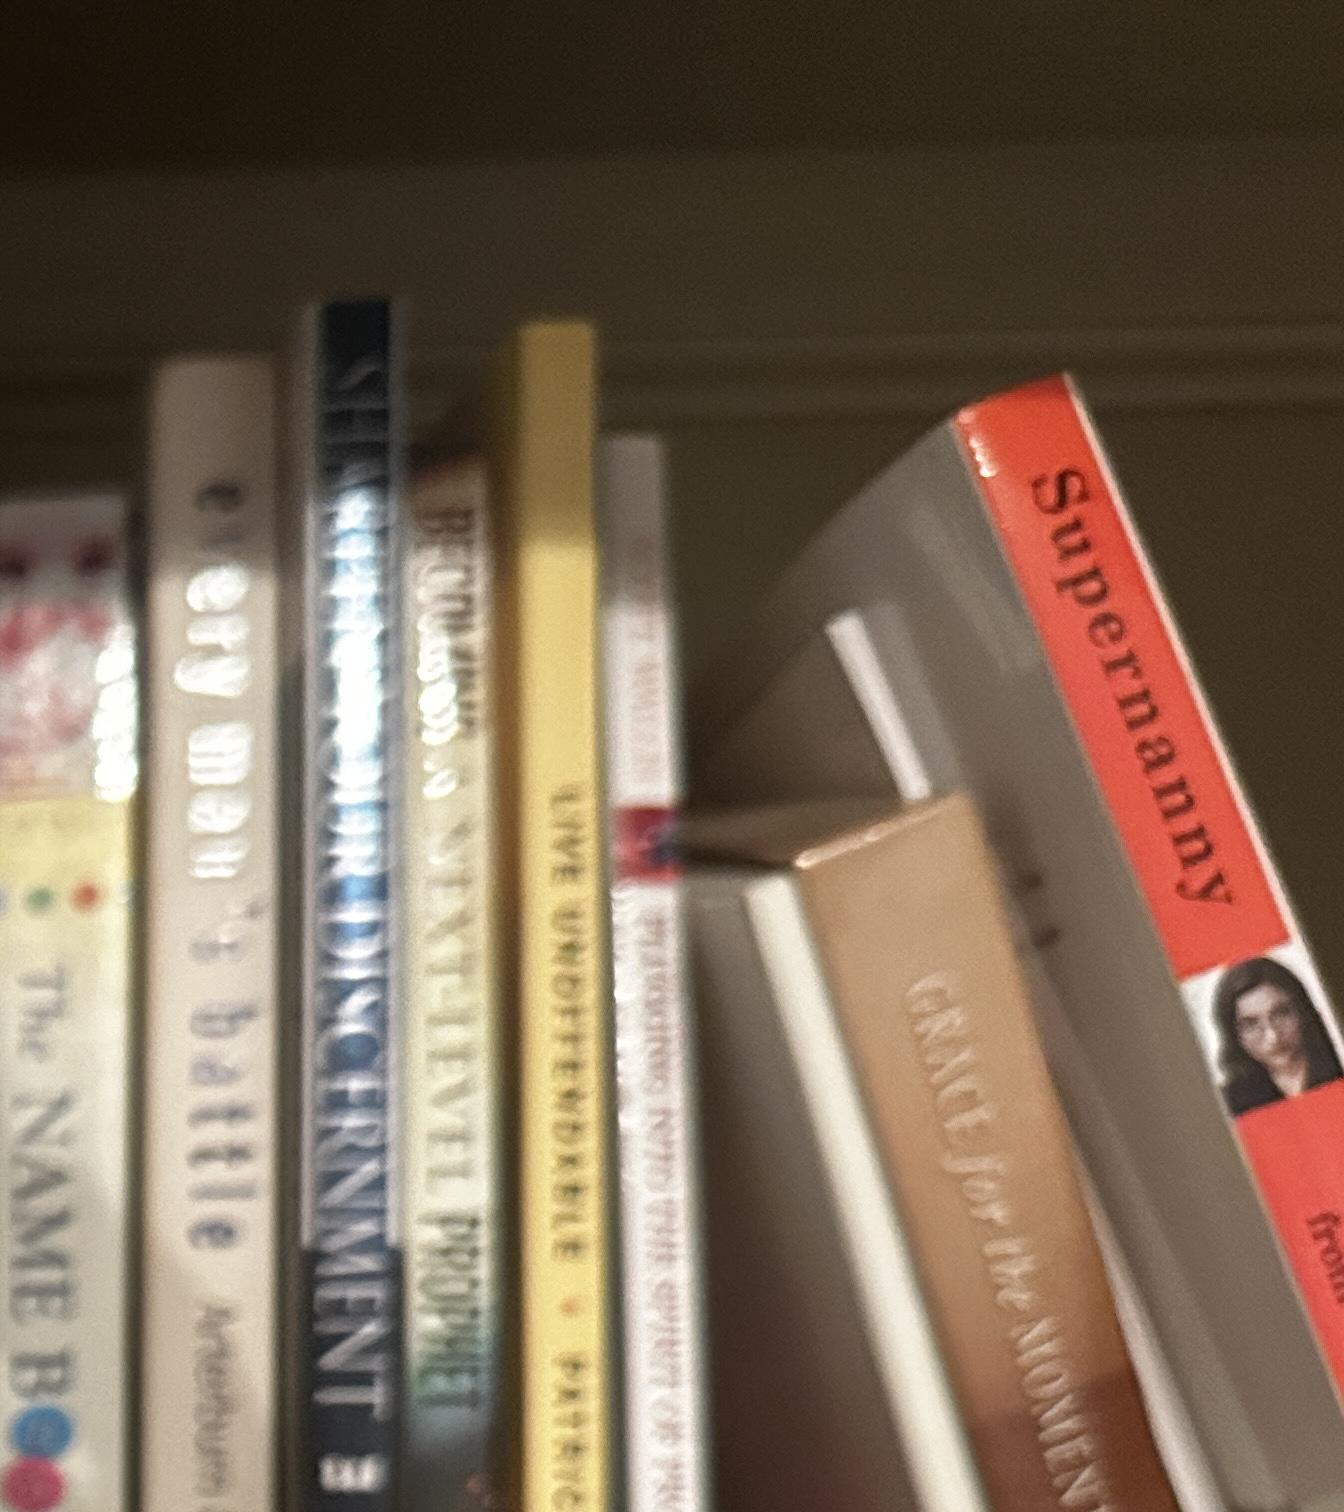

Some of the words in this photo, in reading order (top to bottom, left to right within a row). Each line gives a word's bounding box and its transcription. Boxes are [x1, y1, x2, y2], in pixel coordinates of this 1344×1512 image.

[1030, 466, 1234, 911] Supernanny
[549, 784, 587, 882] LIVE
[17, 963, 67, 1066] The
[550, 906, 589, 1262] UNOFFENDABLE
[907, 970, 997, 1153] GRACE
[9, 1089, 76, 1325] NAME
[187, 1004, 265, 1251] battle
[313, 900, 394, 1420] DISCERNMENT
[945, 1153, 1009, 1226] for
[981, 1236, 1033, 1314] the
